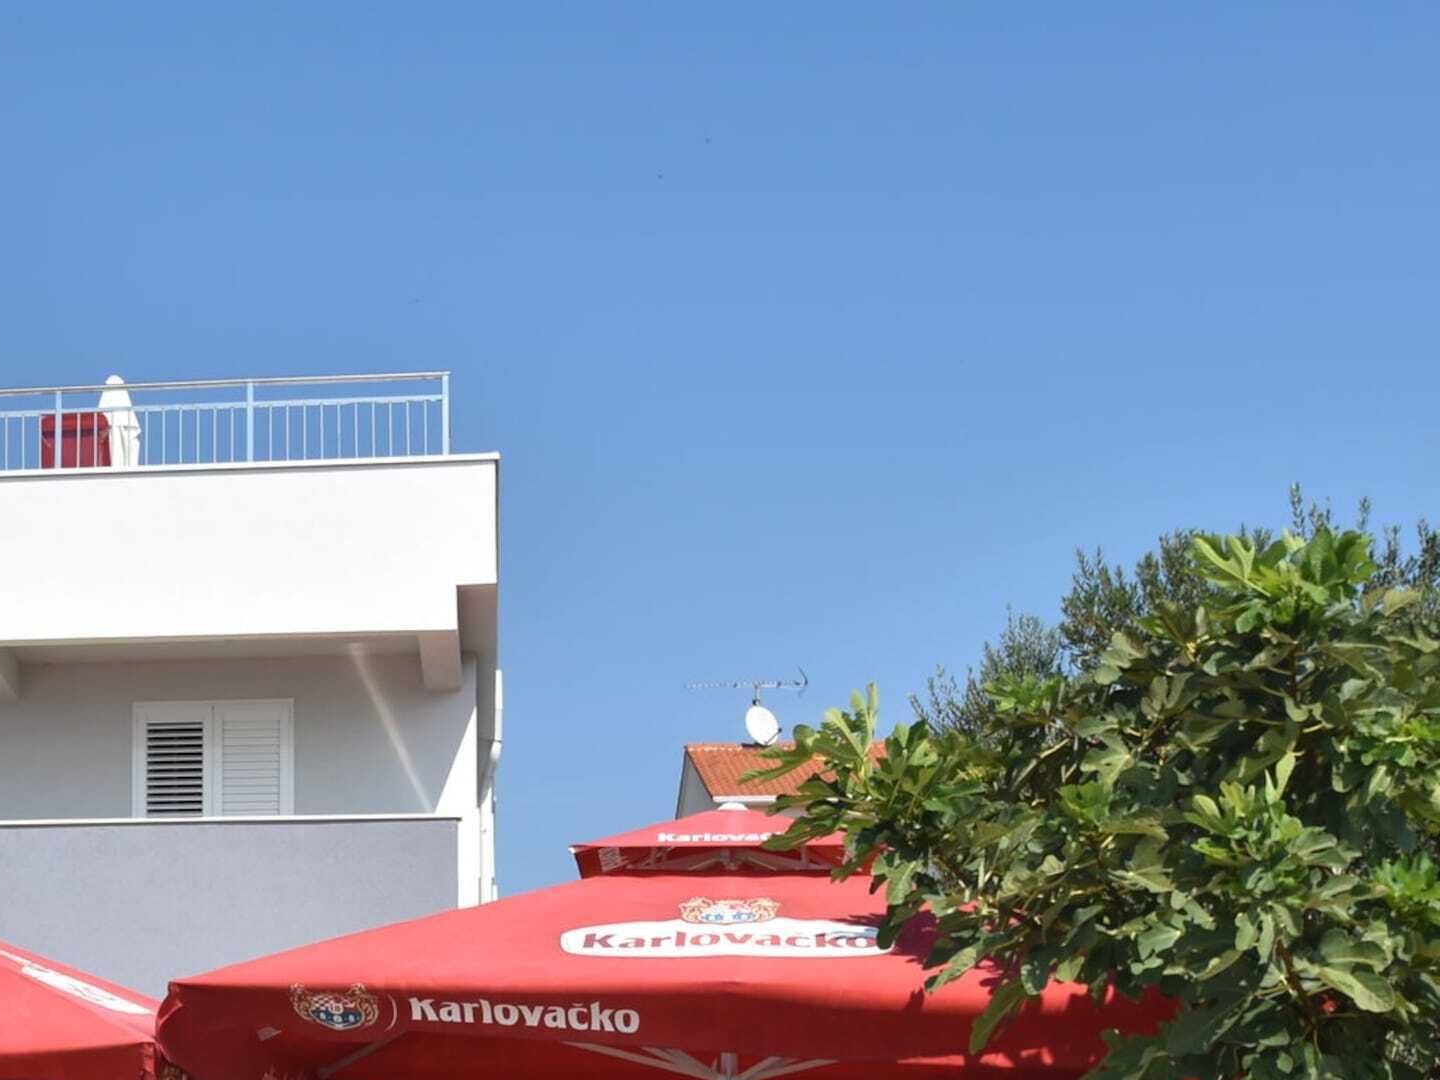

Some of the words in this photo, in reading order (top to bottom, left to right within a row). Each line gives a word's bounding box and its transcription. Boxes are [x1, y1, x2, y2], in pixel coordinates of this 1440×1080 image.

[657, 832, 781, 842] Karlova
[583, 930, 878, 949] Karlovačko
[409, 997, 640, 1034] Karlovačko
